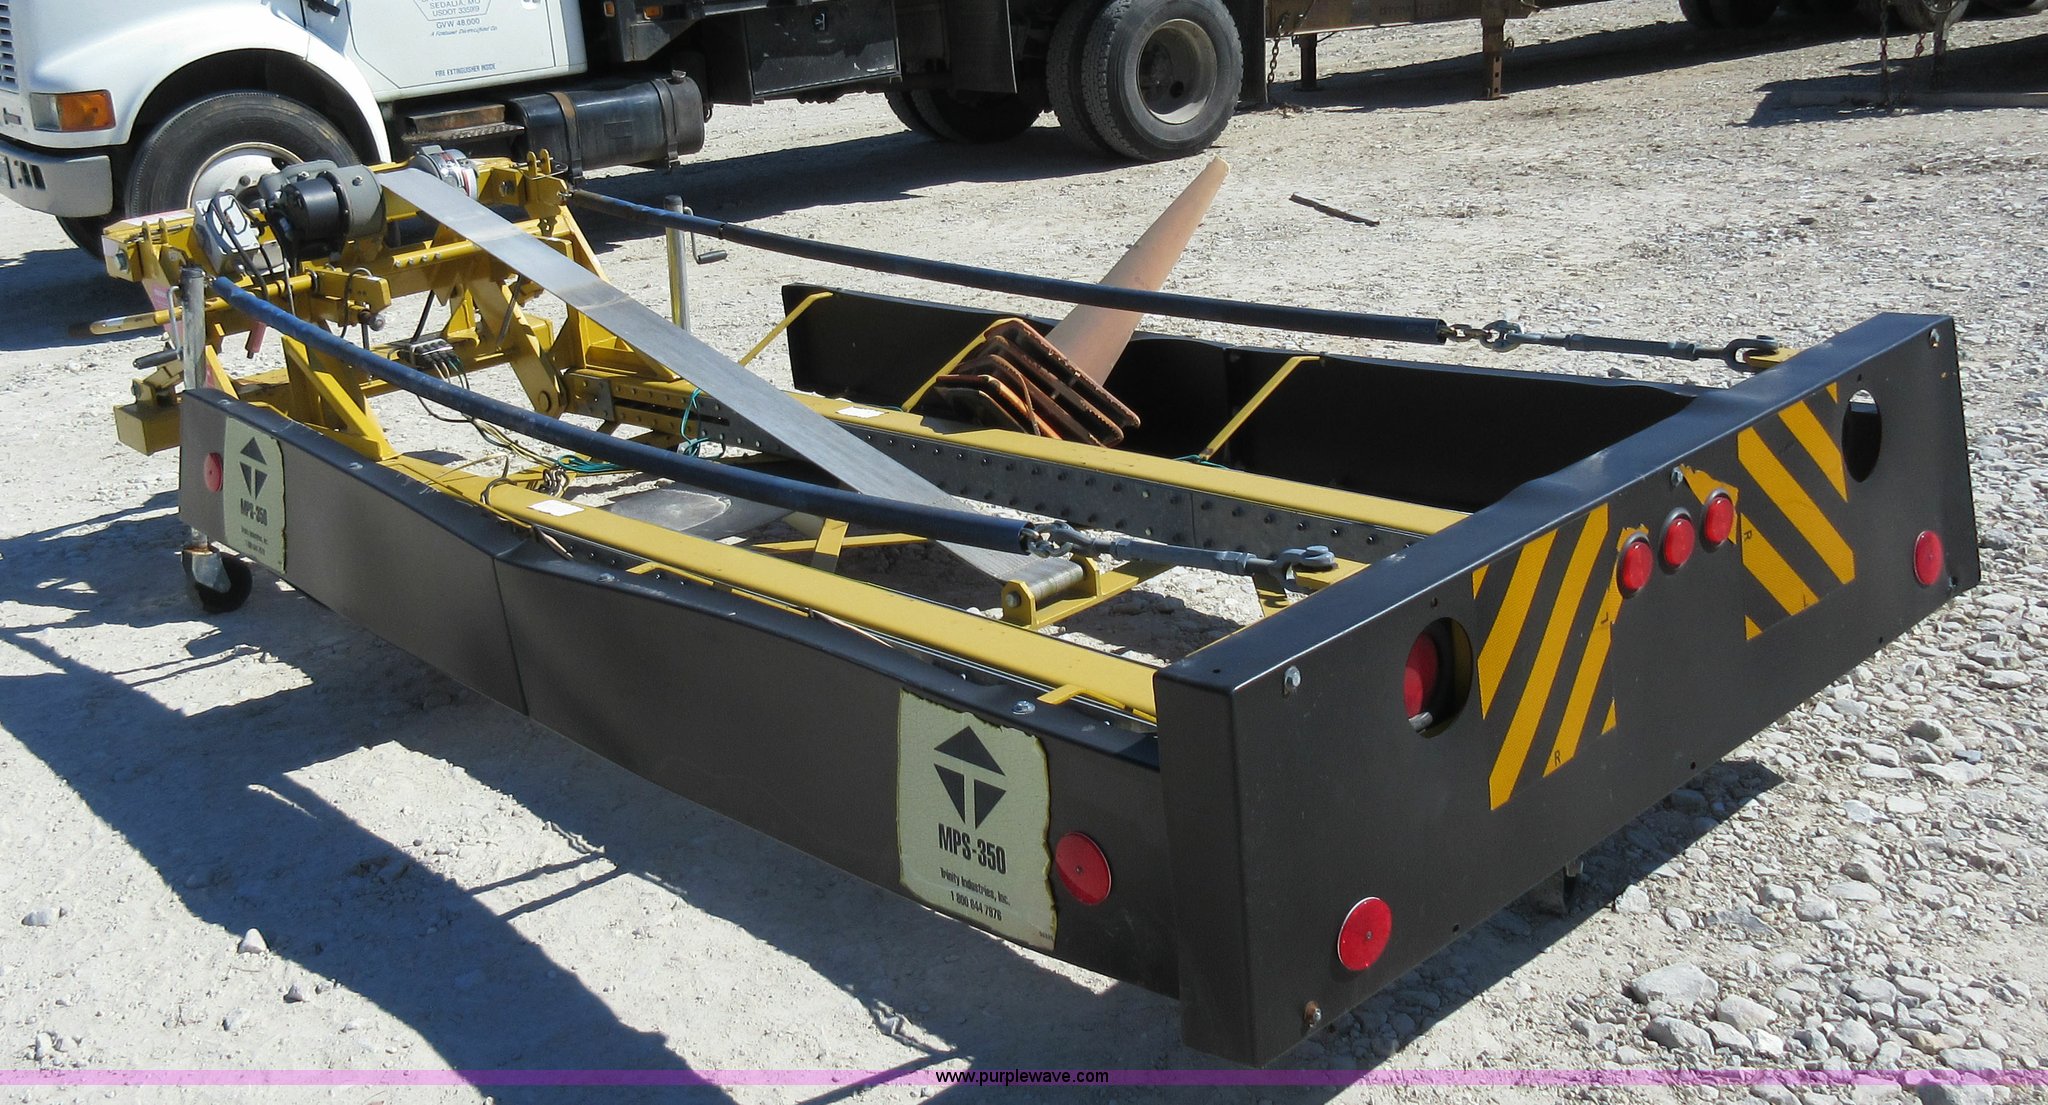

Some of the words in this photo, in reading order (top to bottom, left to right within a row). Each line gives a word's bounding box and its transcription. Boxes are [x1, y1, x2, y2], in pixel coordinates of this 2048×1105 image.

[432, 8, 456, 16] USDOT
[436, 21, 455, 29] GVW
[938, 822, 1007, 875] MPS-350
[940, 867, 960, 886] Trinity
[961, 876, 997, 902] Industries,
[950, 890, 954, 901] 1
[956, 893, 969, 908] 800
